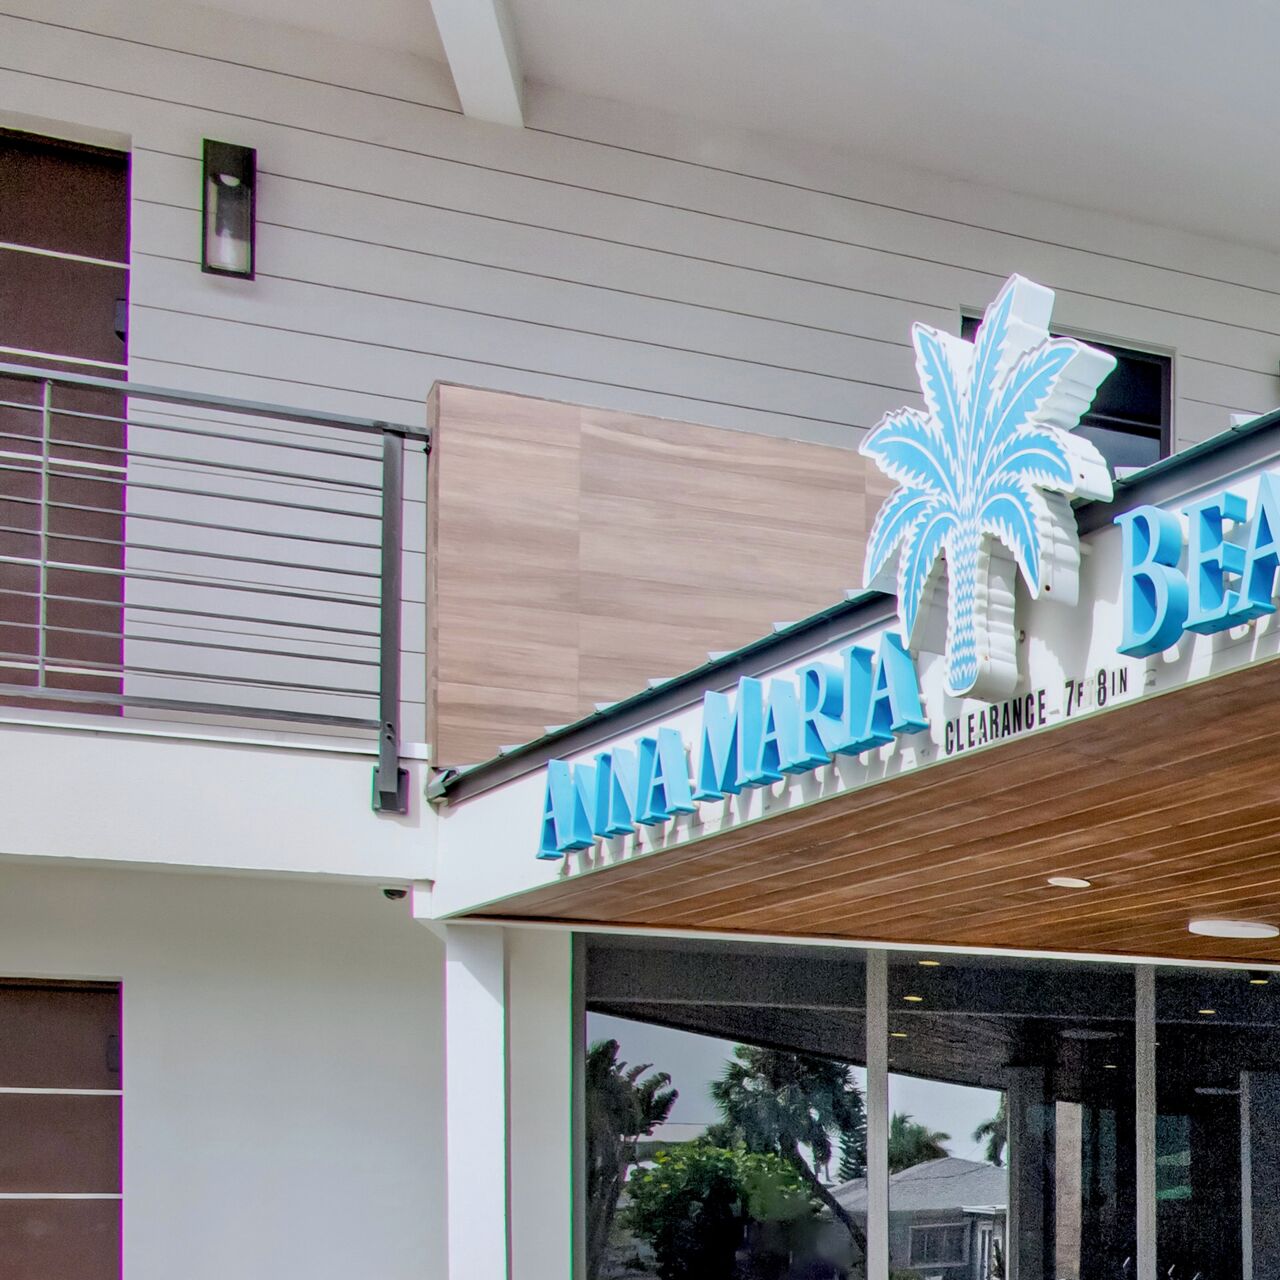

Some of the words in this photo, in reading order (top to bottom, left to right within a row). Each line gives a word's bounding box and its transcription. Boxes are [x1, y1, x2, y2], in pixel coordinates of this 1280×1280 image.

[536, 727, 697, 860] ANNA
[692, 631, 929, 803] MARIA
[945, 689, 1046, 755] CLEARANCE
